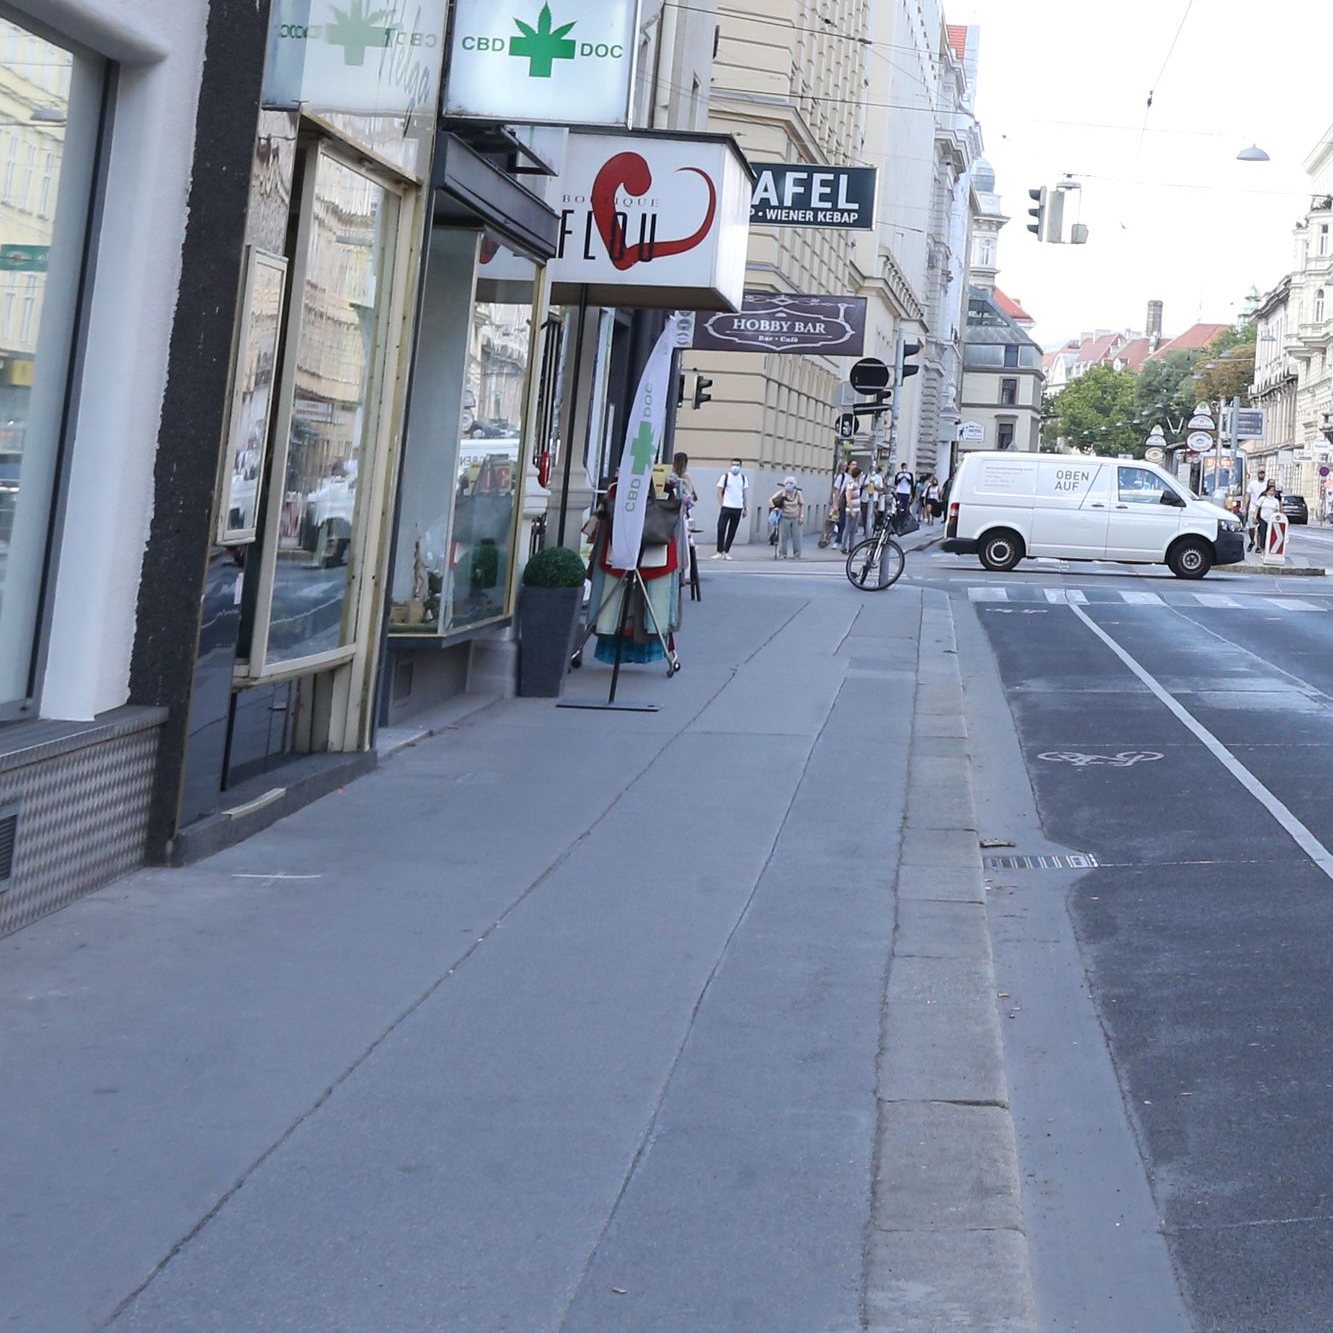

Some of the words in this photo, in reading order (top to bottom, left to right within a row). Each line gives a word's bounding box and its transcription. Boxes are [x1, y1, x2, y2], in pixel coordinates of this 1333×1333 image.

[462, 36, 505, 52] CBD
[580, 42, 624, 59] DOC
[751, 170, 860, 210] AFEL
[766, 208, 814, 222] WIENER
[817, 211, 859, 224] KEBAP
[557, 209, 658, 263] FLOU
[732, 318, 791, 333] HOBBY
[794, 322, 827, 335] BAR
[757, 334, 774, 342] Bar
[1056, 469, 1090, 482] OBEN
[1054, 481, 1080, 492] AUF
[624, 478, 642, 513] CBD
